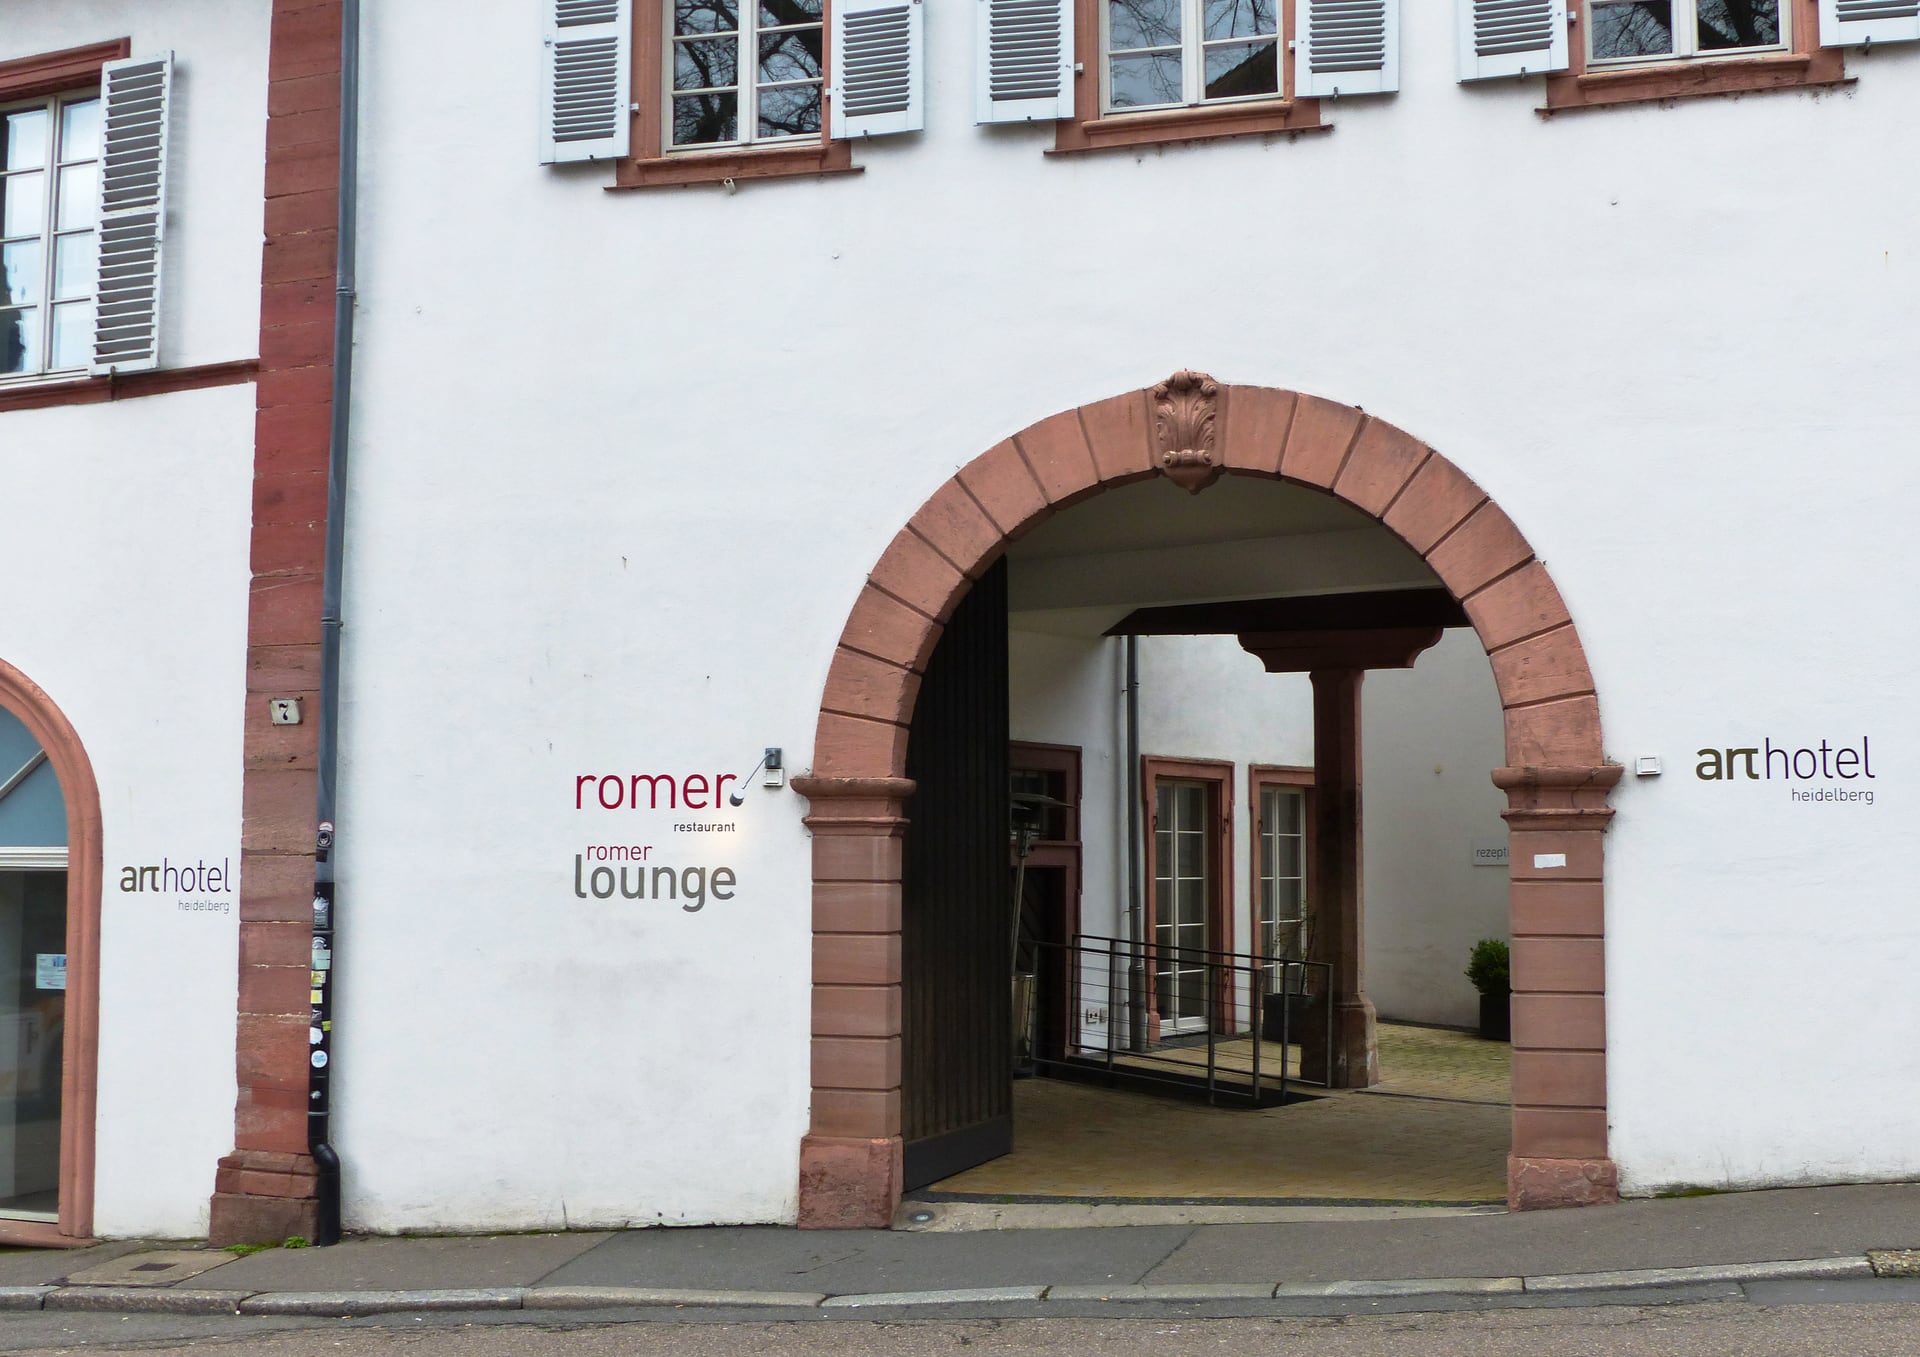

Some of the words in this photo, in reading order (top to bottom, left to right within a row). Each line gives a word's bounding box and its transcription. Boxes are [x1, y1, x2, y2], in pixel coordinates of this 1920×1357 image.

[279, 703, 289, 720] 7
[576, 774, 738, 809] romer
[1792, 788, 1874, 805] heidelberg
[673, 822, 736, 833] restaurant
[587, 845, 653, 861] romer
[575, 854, 736, 912] lounge
[178, 899, 230, 914] heidelberg
